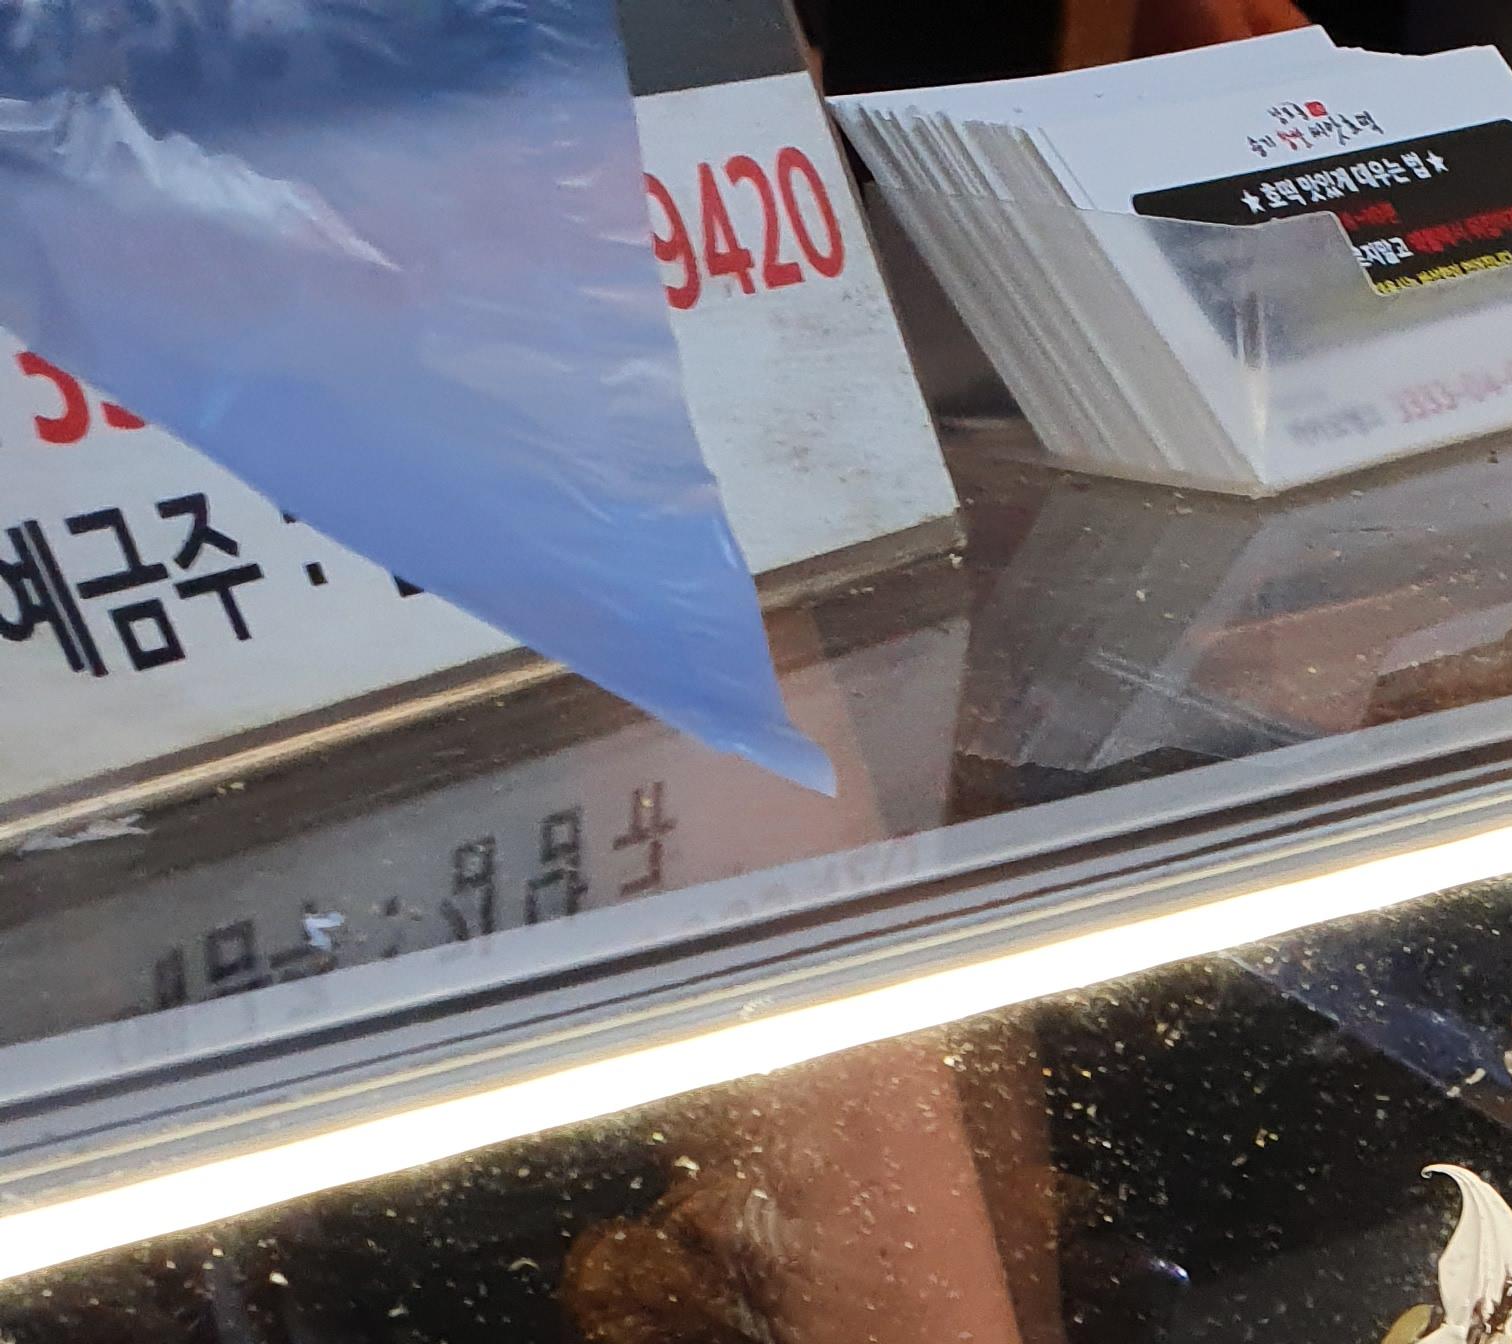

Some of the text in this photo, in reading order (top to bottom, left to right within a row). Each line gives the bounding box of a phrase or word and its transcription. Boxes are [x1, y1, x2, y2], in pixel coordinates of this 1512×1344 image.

[643, 146, 846, 310] 9420
[1259, 179, 1307, 208] 호떡
[1296, 166, 1360, 203] 맛있게
[1400, 150, 1433, 179] 법
